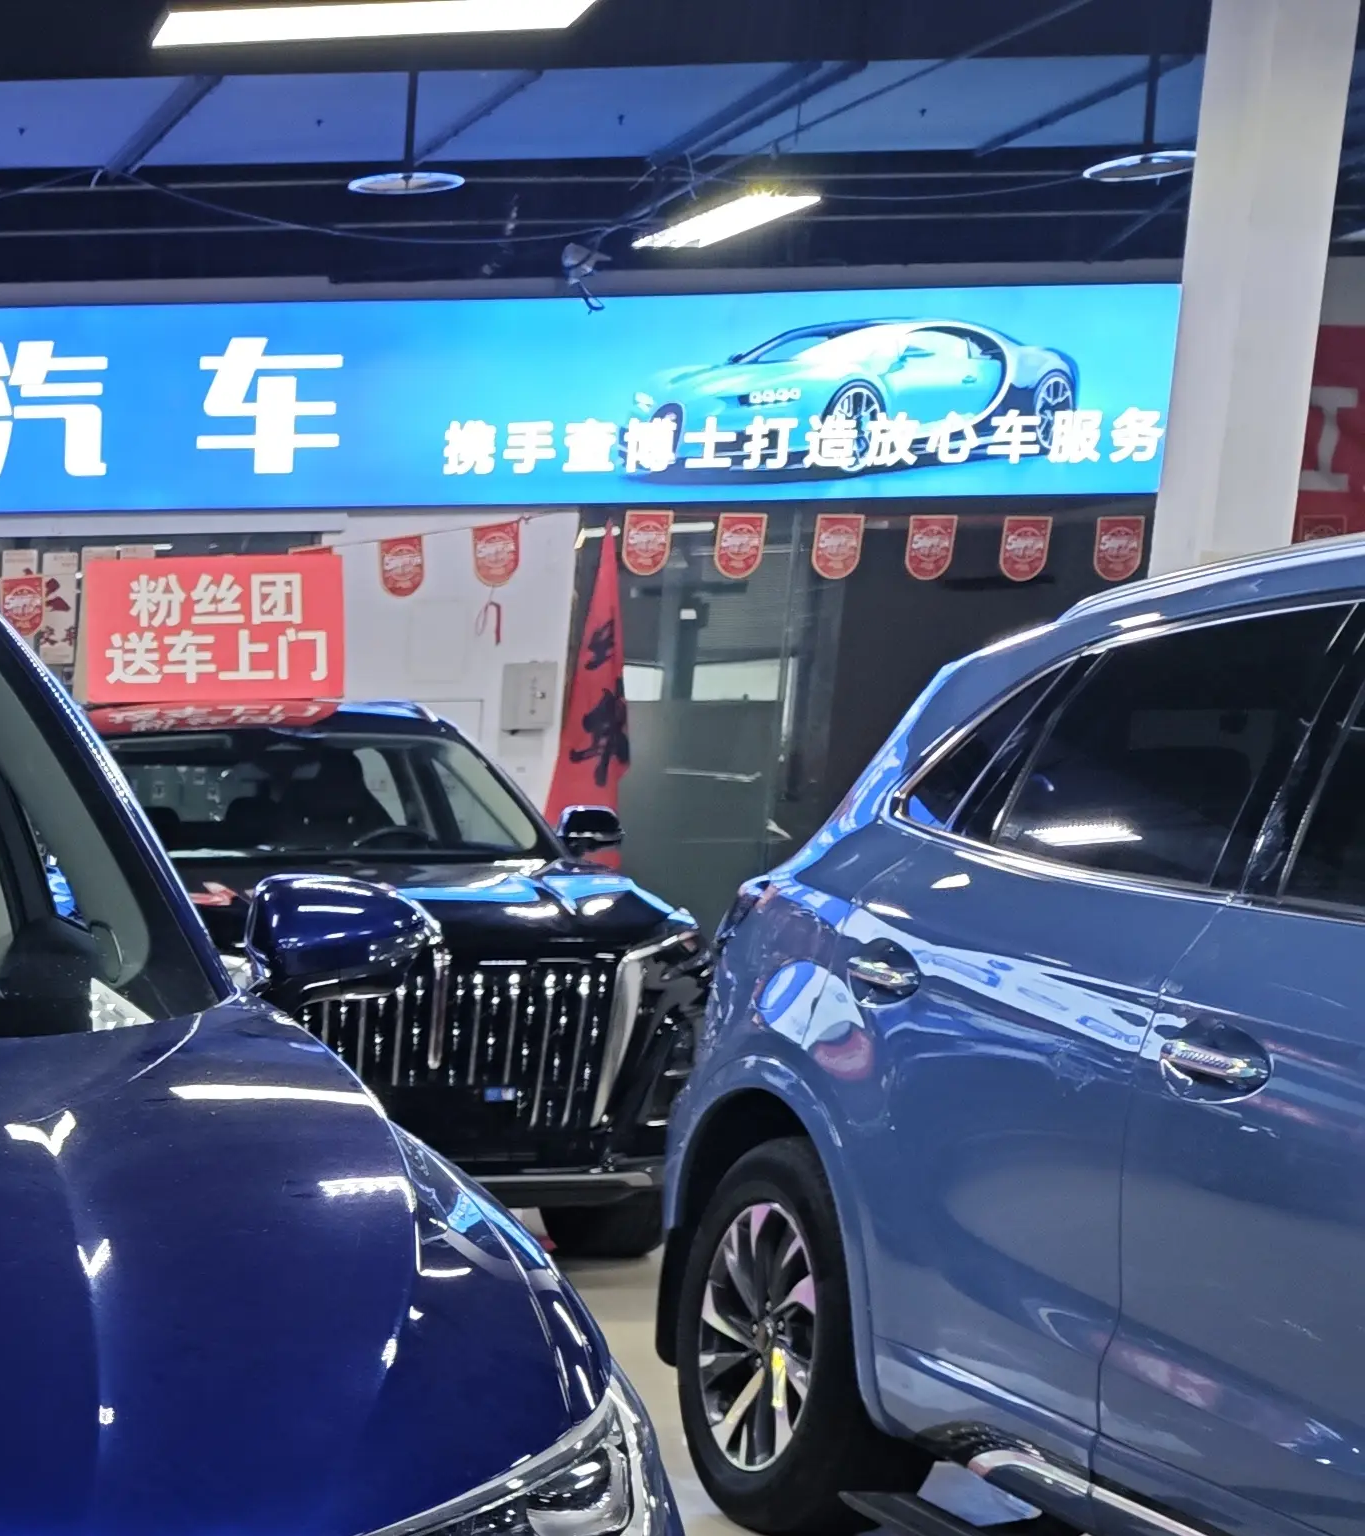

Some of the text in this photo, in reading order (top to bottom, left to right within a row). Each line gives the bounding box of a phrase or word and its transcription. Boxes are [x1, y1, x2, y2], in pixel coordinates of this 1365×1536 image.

[129, 573, 303, 627] 粉丝团
[105, 628, 329, 684] 送车上门
